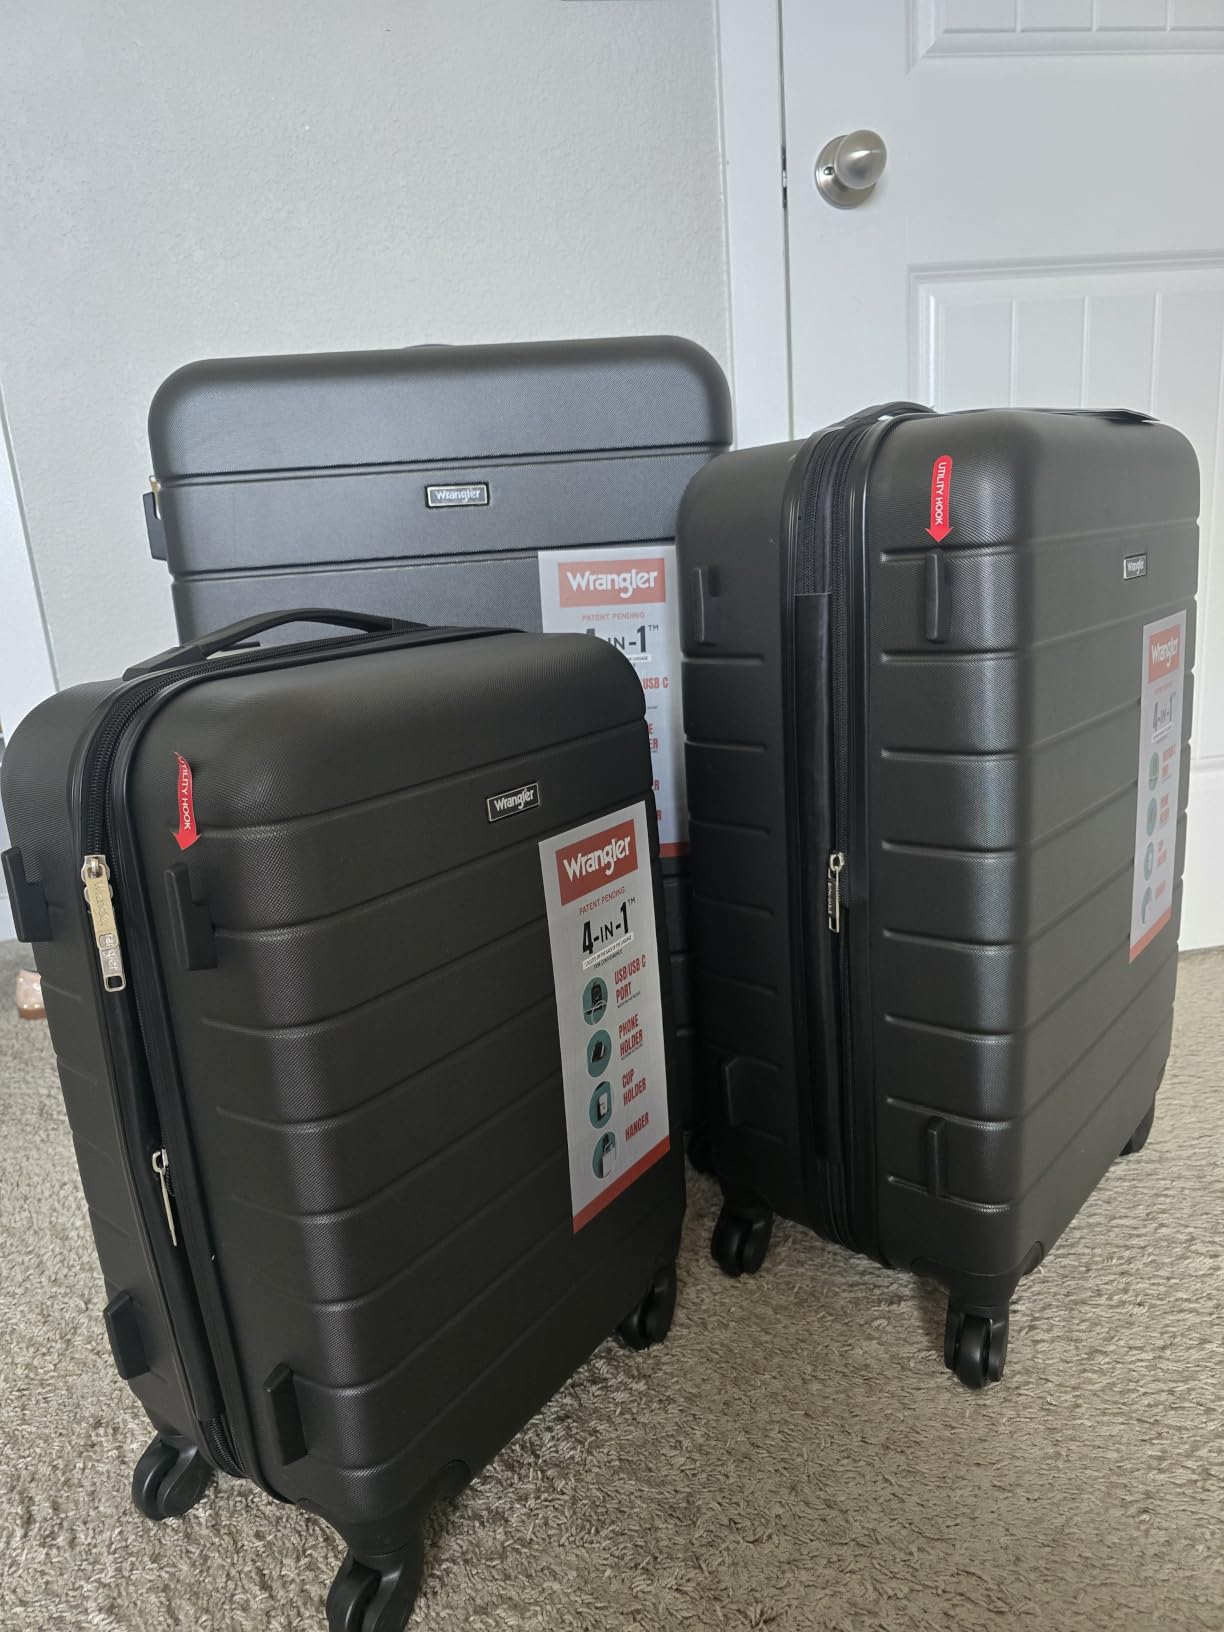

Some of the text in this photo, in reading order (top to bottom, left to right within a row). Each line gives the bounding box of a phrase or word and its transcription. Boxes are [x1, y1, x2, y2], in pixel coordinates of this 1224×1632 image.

[435, 489, 480, 503] Wrangler
[935, 462, 947, 525] UTILITY HOOK
[566, 569, 658, 599] Wrangler
[581, 611, 645, 622] PATENT PENDING
[494, 788, 534, 812] Wrangler
[182, 798, 191, 830] HOOK
[563, 836, 631, 883] Wrangler
[579, 886, 625, 915] PATENT PENDING
[583, 901, 629, 954] 4-IN-1
[614, 958, 640, 985] USB/USB
[616, 982, 632, 1004] PORT
[618, 1013, 639, 1039] PHONE
[620, 1029, 643, 1056] HOLDER
[622, 1068, 635, 1089] CUP
[623, 1078, 646, 1106] HOLDER
[625, 1112, 649, 1142] HANGER
